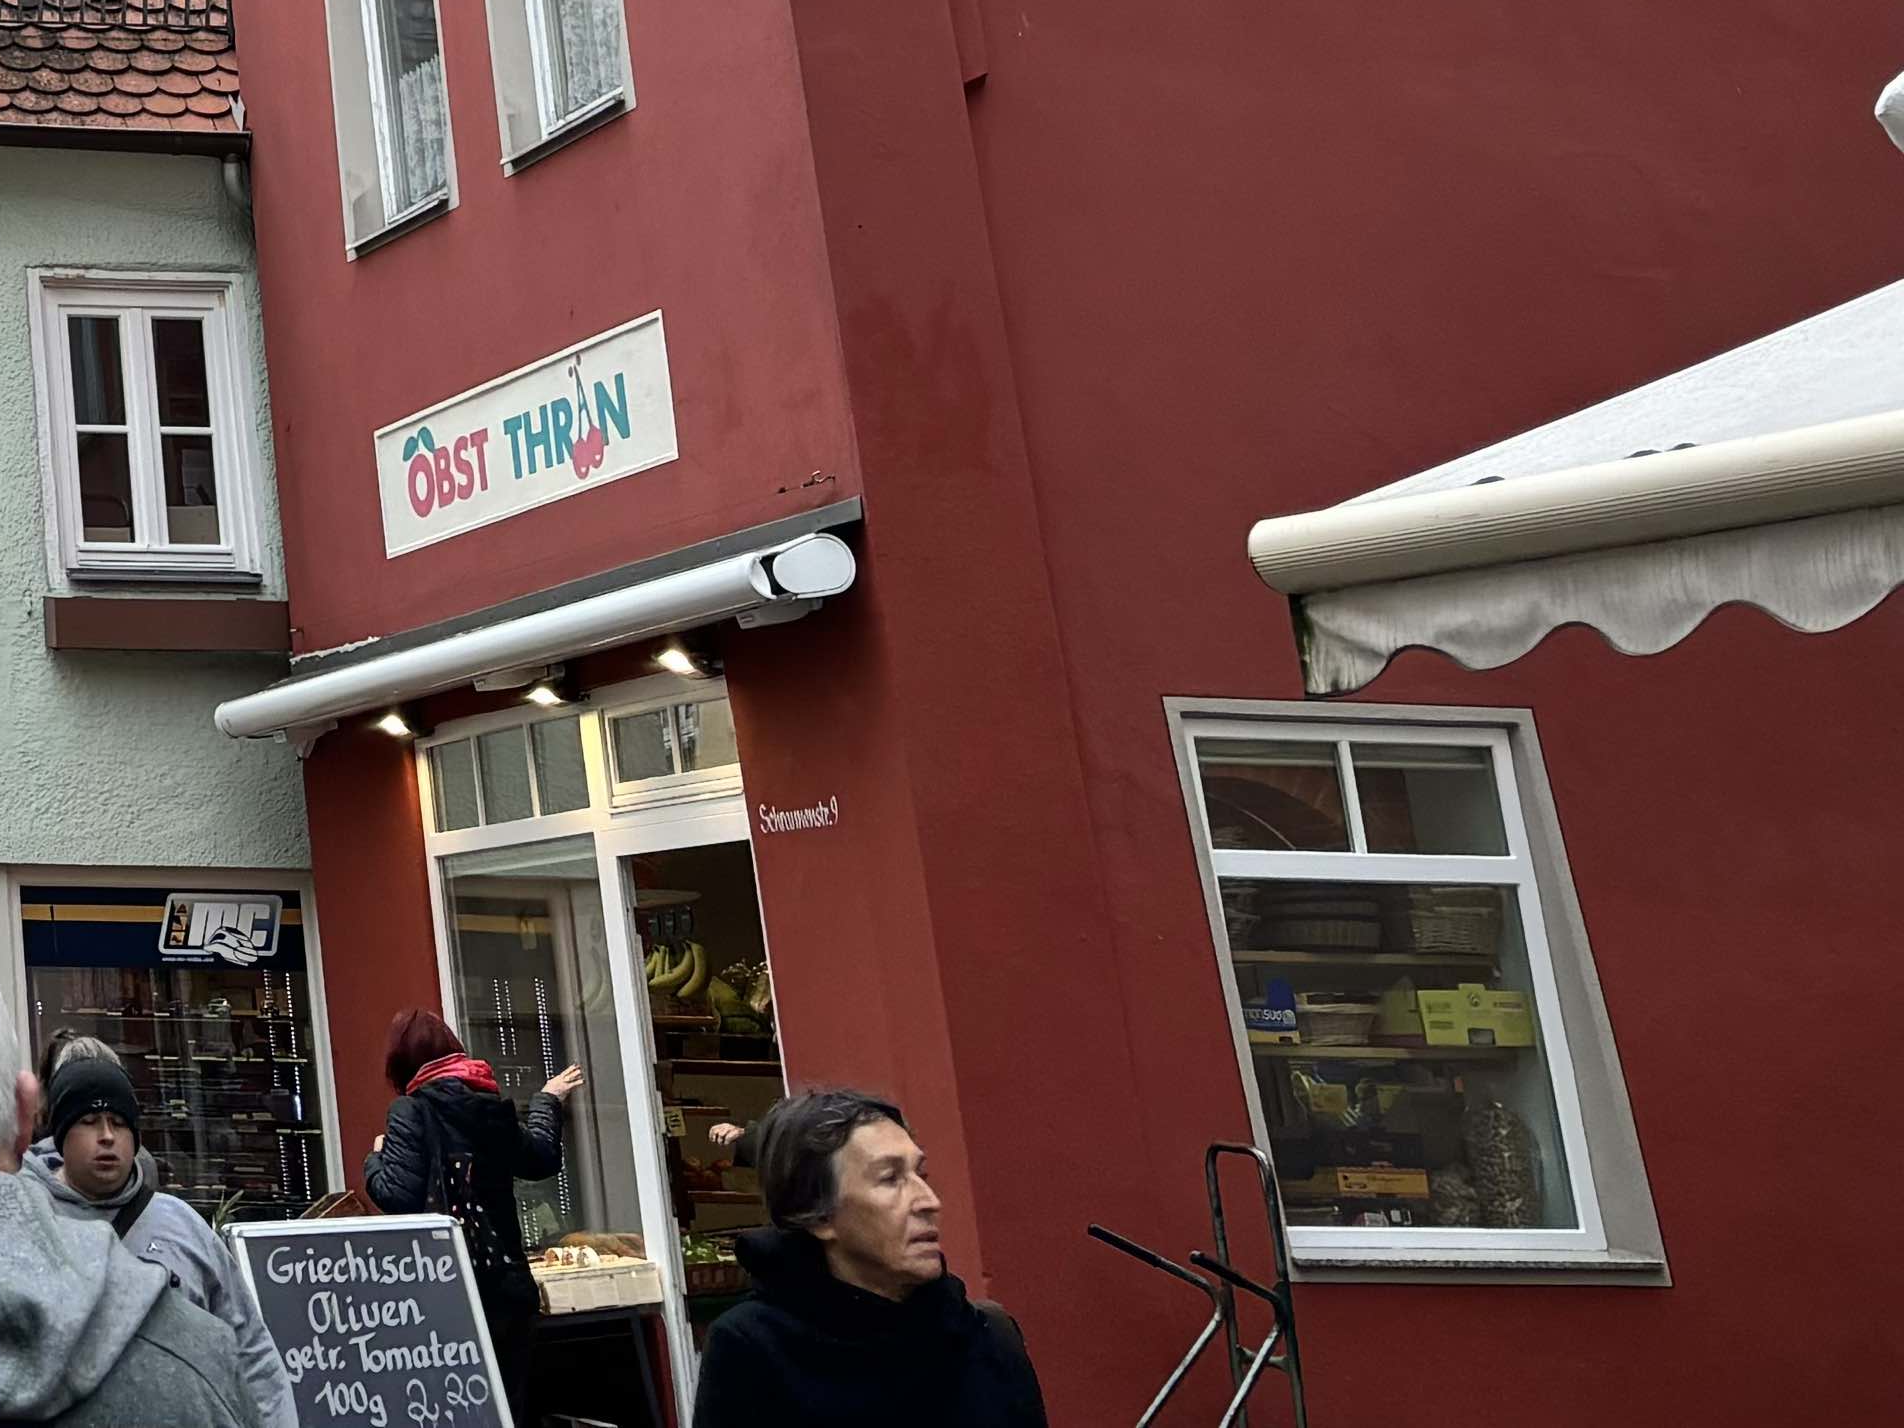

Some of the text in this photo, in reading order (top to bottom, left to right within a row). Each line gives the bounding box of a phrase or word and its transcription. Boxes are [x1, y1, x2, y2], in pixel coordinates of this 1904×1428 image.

[408, 428, 489, 518] OBST
[266, 1239, 457, 1284] Griechische
[307, 1291, 425, 1334] Oliven
[285, 1331, 481, 1384] getr. Tomaten
[314, 1372, 489, 1428] 100g 2,20
